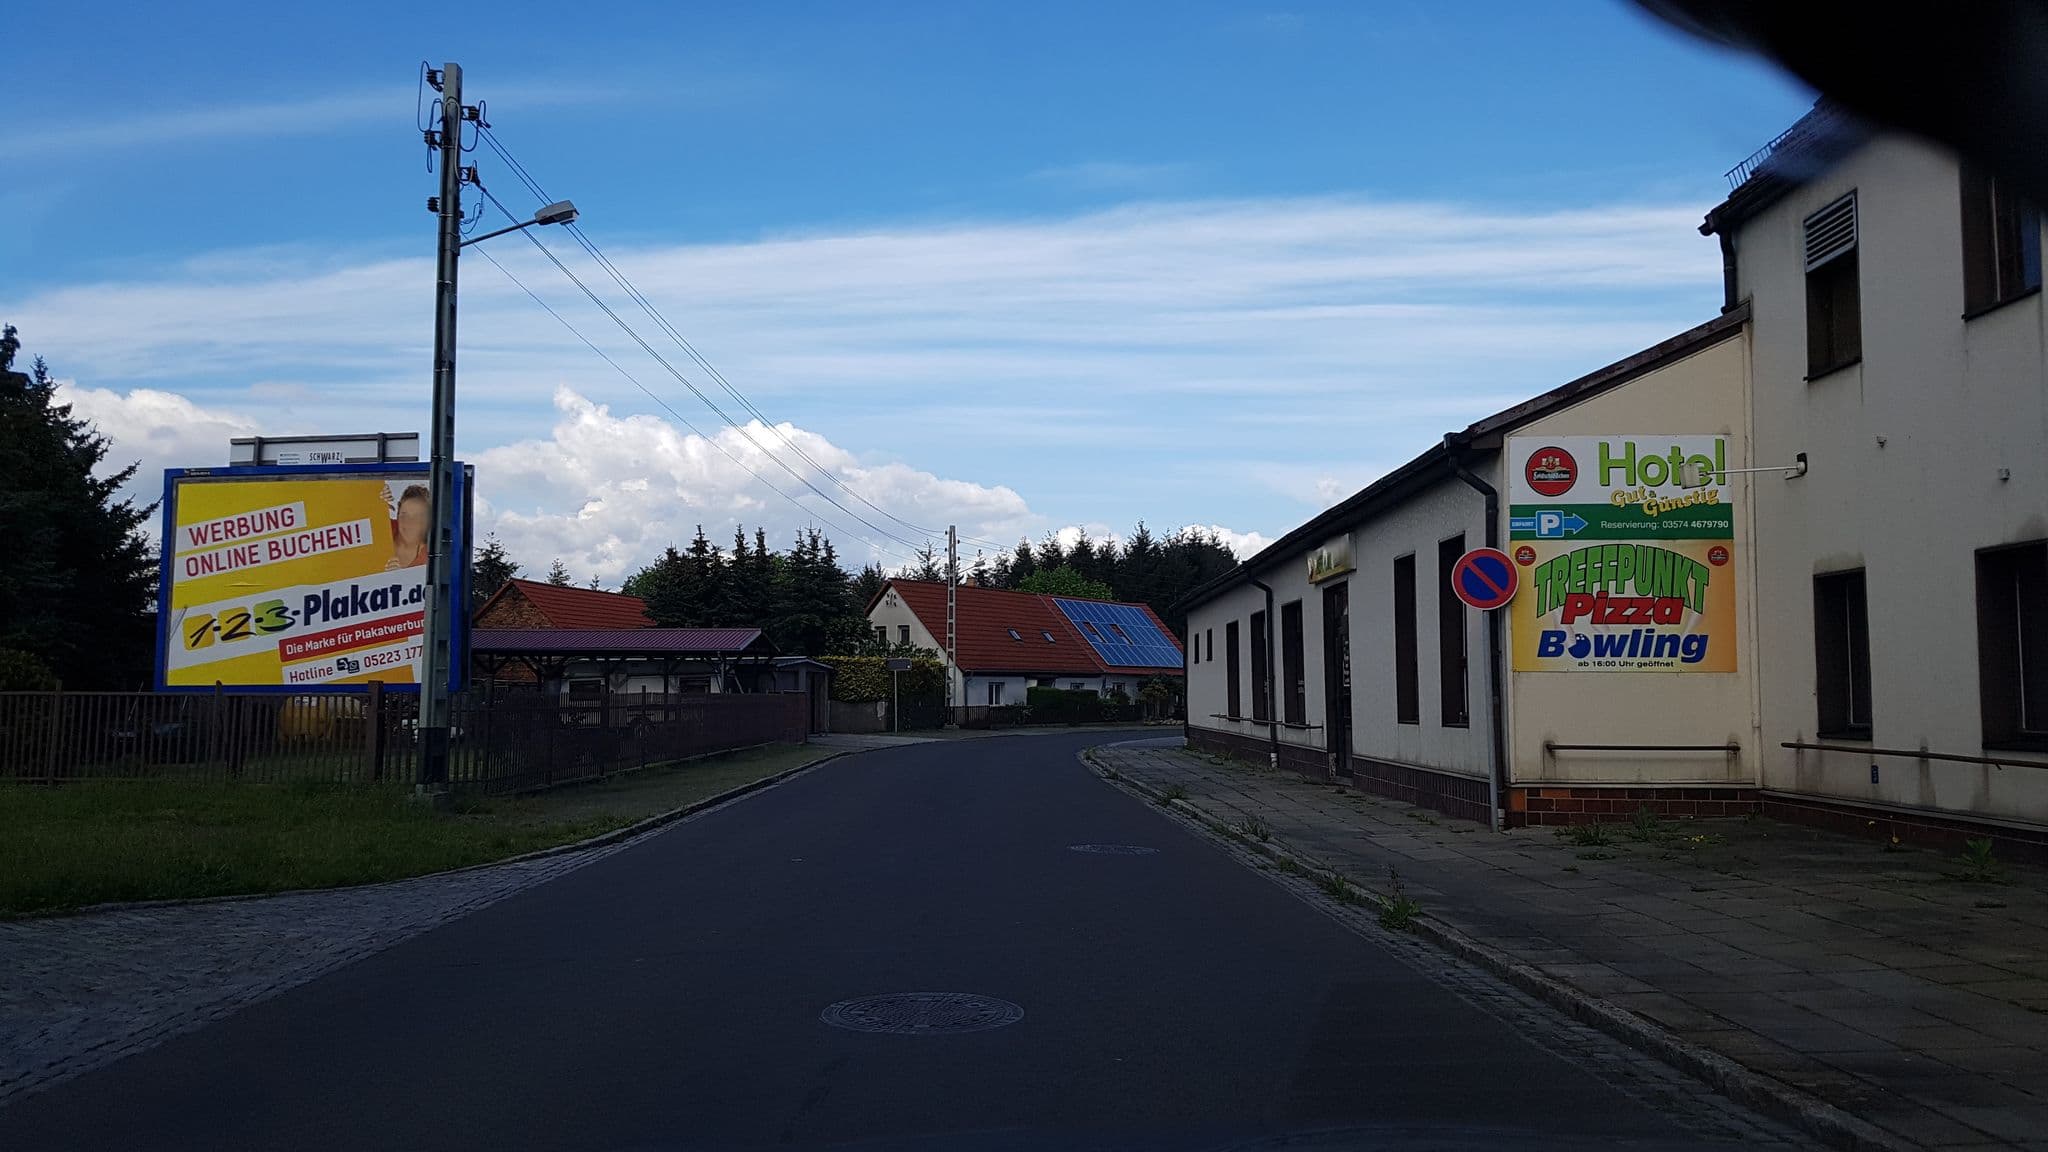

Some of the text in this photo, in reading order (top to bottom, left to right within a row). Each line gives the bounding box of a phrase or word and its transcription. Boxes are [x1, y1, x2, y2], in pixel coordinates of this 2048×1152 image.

[1599, 438, 1726, 488] Hotel
[1611, 486, 1647, 508] Gut
[1643, 487, 1719, 517] Günstig
[188, 507, 296, 546] WERBUNG
[1541, 514, 1560, 535] P
[1600, 521, 1729, 530] Reservierung: 03574 4679790
[185, 523, 363, 578] ONLINE BUCHEN!
[1534, 544, 1709, 618] TREFFPUNKT
[1561, 591, 1685, 625] Pizza
[286, 644, 303, 655] Die
[305, 636, 336, 651] Marke
[338, 631, 352, 644] für
[1537, 628, 1708, 663] Bowling
[290, 665, 333, 683] Hotline
[364, 650, 401, 668] 05223
